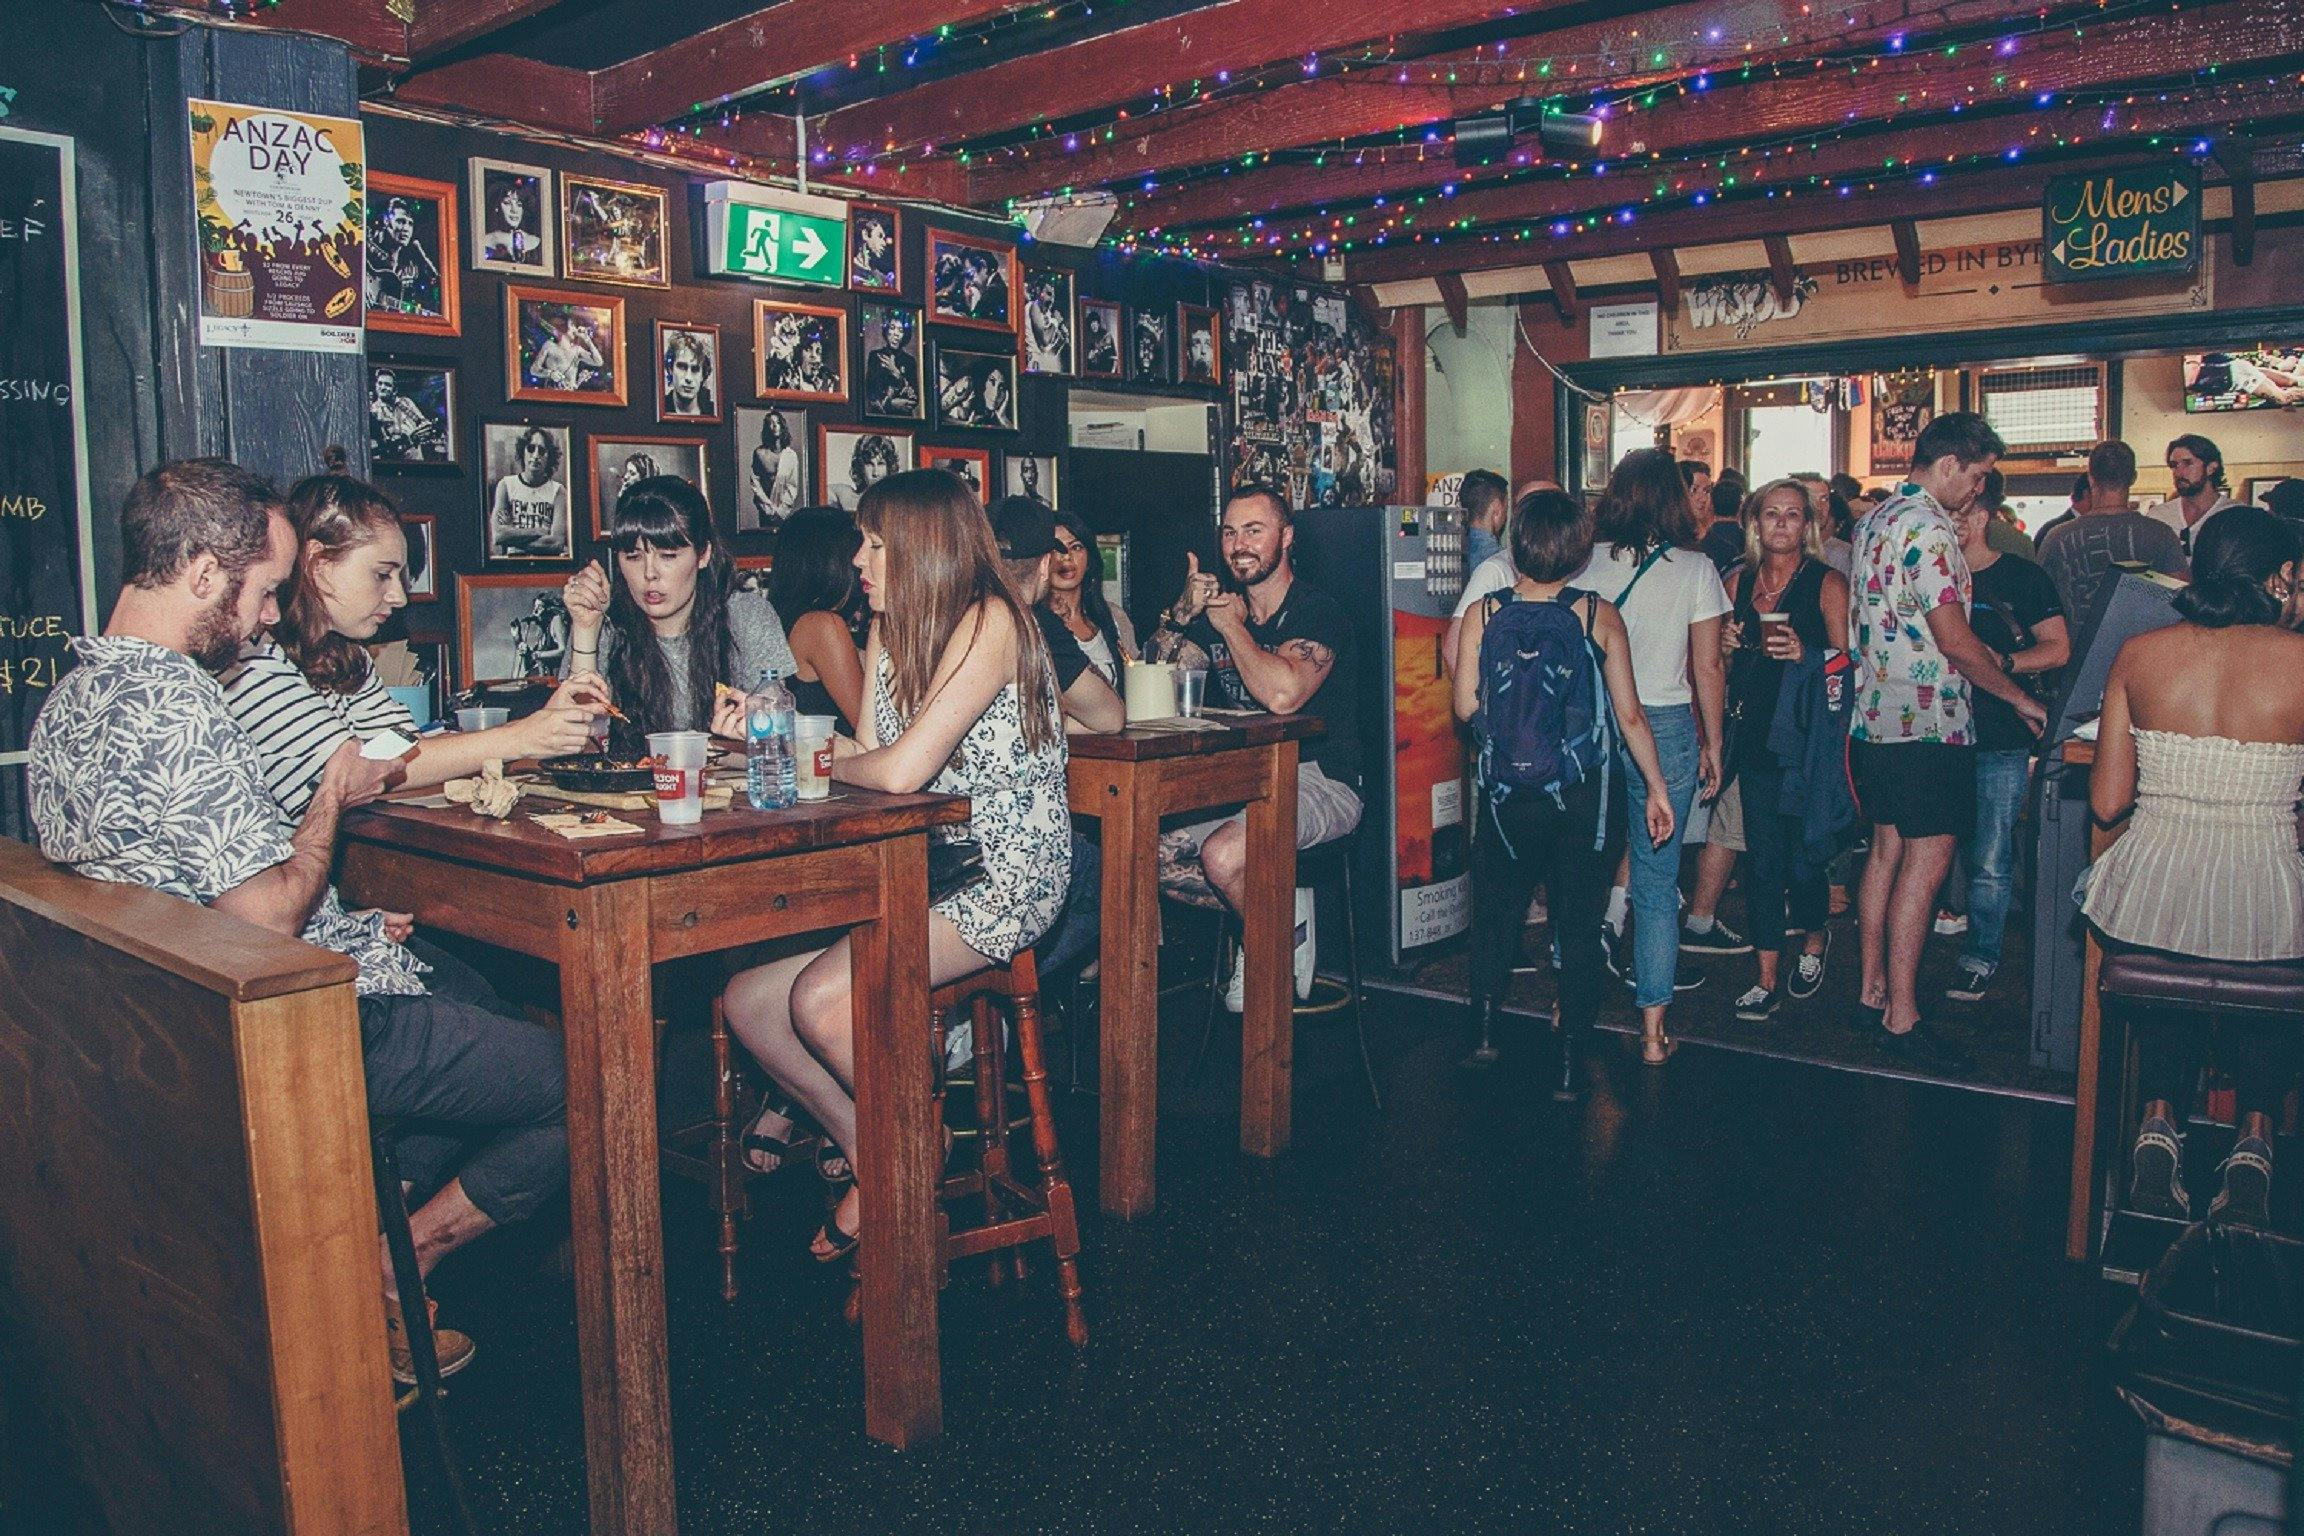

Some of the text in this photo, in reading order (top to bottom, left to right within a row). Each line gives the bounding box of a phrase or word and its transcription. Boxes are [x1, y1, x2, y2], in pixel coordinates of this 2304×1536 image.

[223, 117, 333, 153] ANZAC
[250, 146, 310, 175] DAY
[2052, 177, 2170, 224] Mens
[275, 209, 294, 224] 26
[2066, 219, 2190, 270] Ladies
[1957, 248, 1986, 272] IN
[1433, 477, 1463, 494] ANZ
